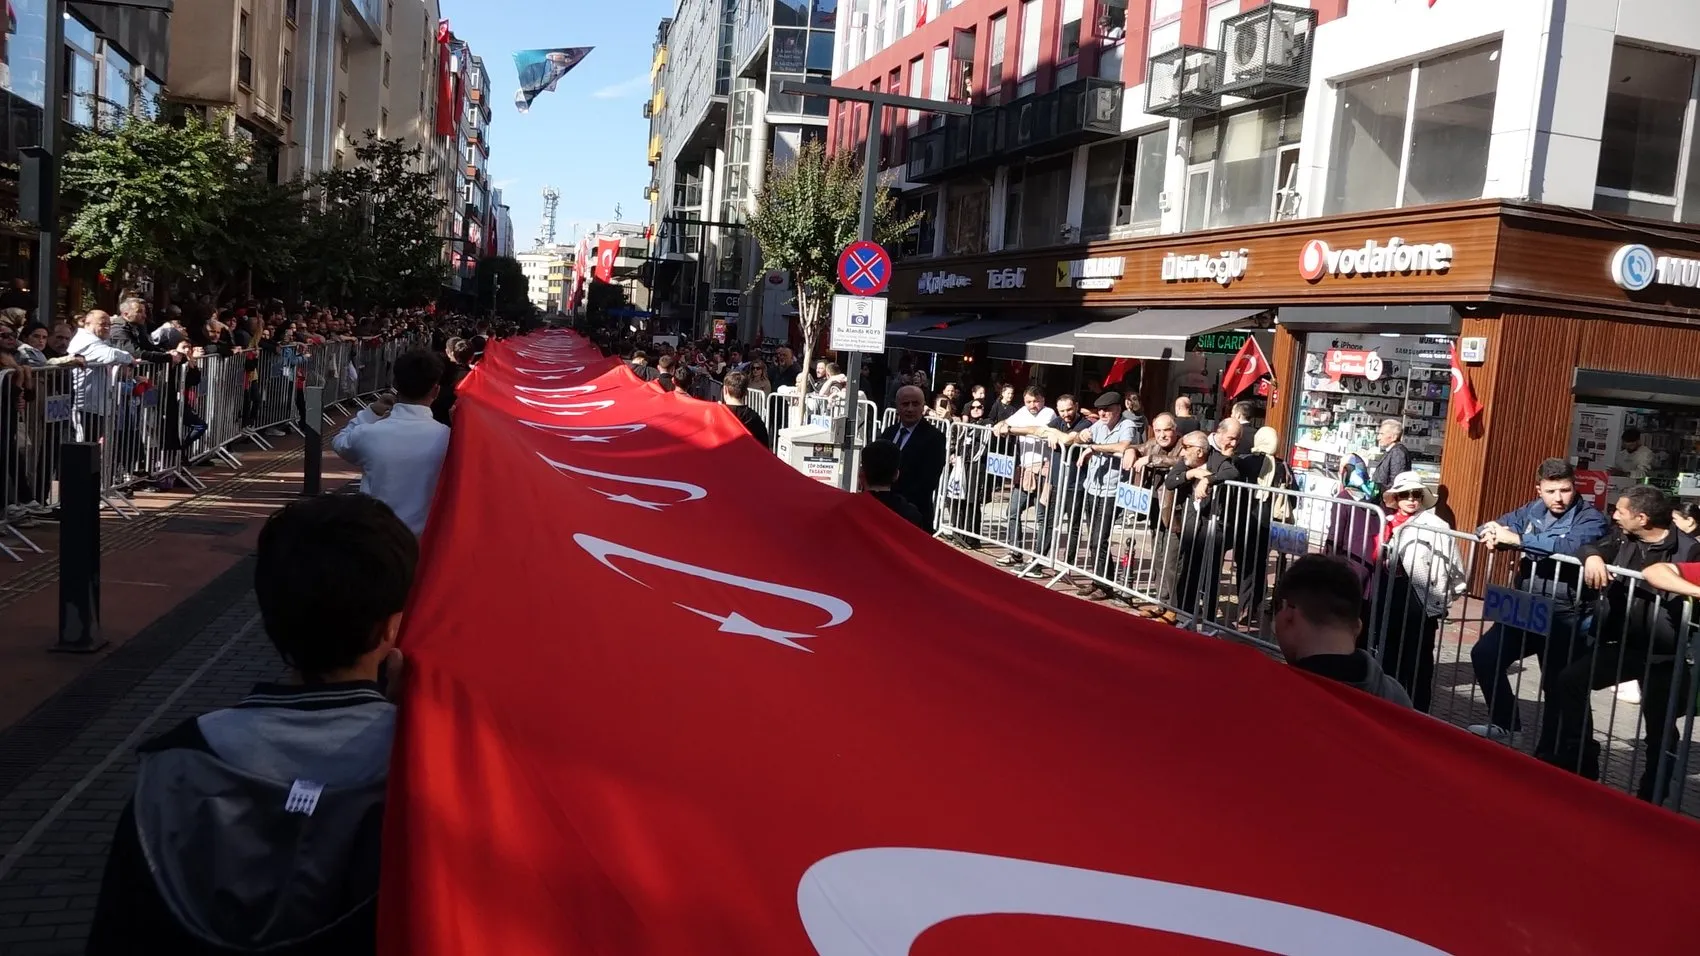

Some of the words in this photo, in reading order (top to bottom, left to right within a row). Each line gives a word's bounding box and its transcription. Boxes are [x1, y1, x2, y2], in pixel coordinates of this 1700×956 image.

[1326, 236, 1453, 274] vodafone
[1198, 335, 1215, 349] SIM
[1217, 335, 1246, 350] CARD
[1368, 358, 1380, 372] 12
